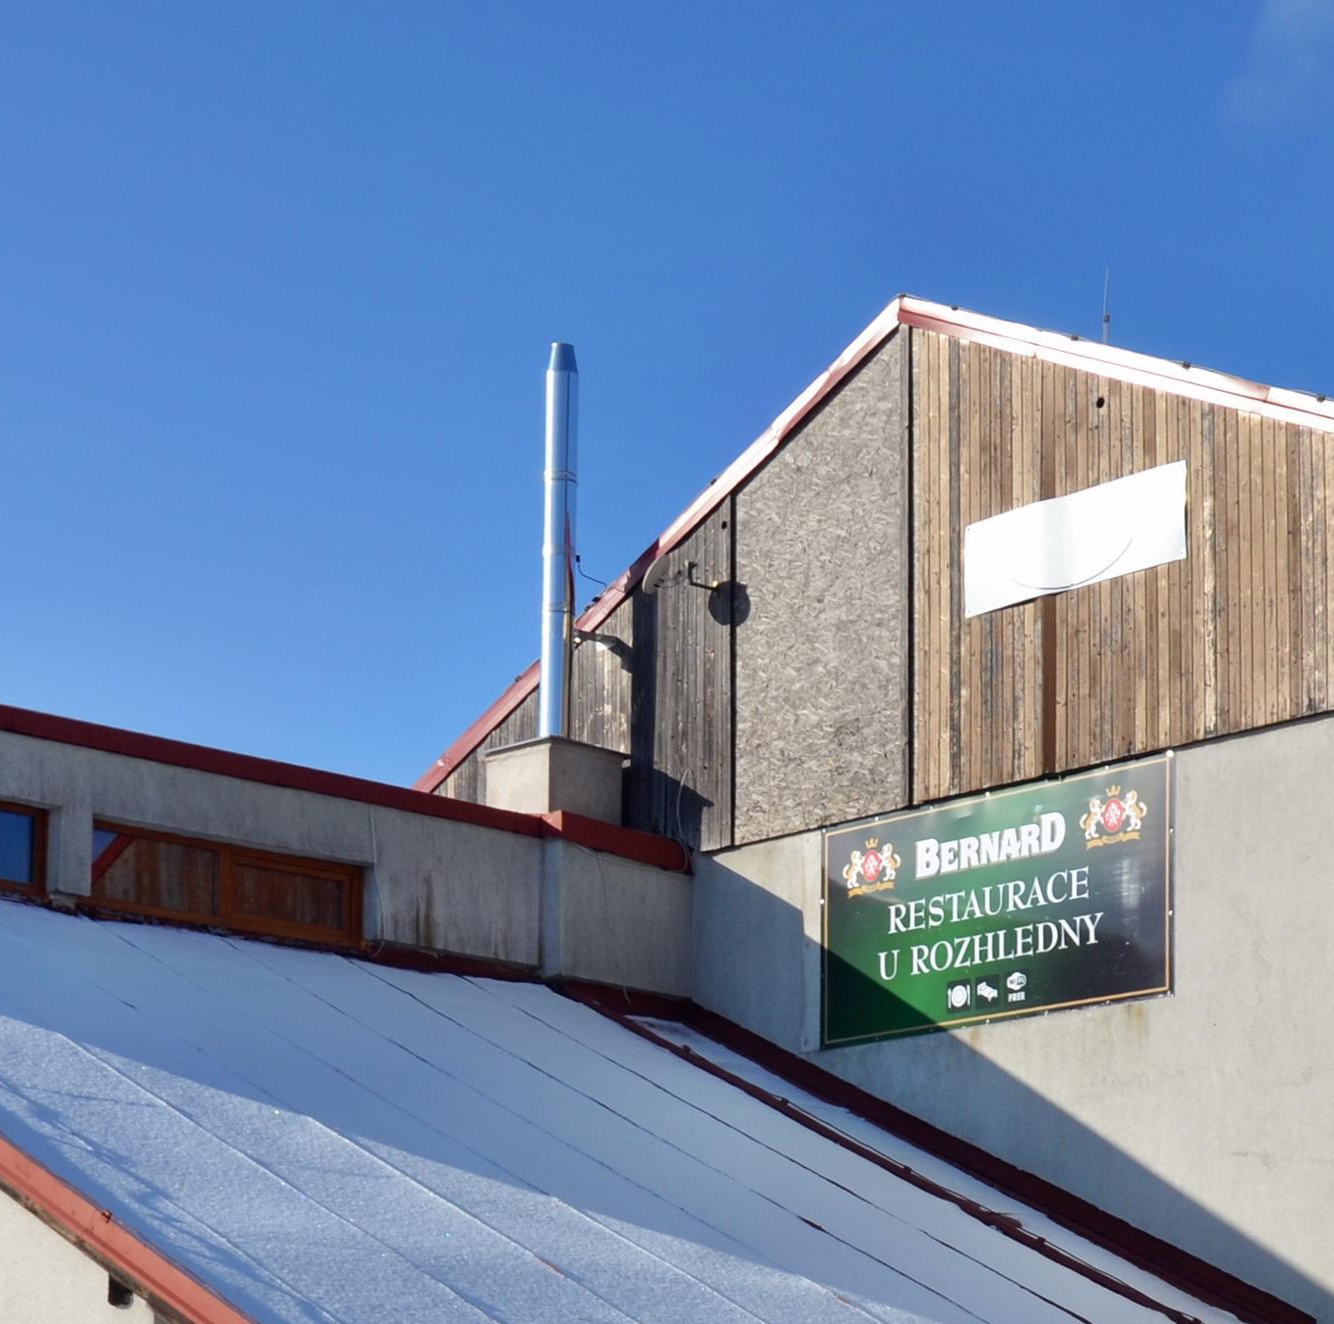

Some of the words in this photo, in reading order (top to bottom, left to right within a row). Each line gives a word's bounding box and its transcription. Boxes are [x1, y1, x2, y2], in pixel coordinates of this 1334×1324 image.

[916, 812, 1066, 880] BERNARD
[887, 866, 1090, 934] RESTAURACE
[878, 951, 900, 981] U
[910, 912, 1105, 976] ROZHLEDNY
